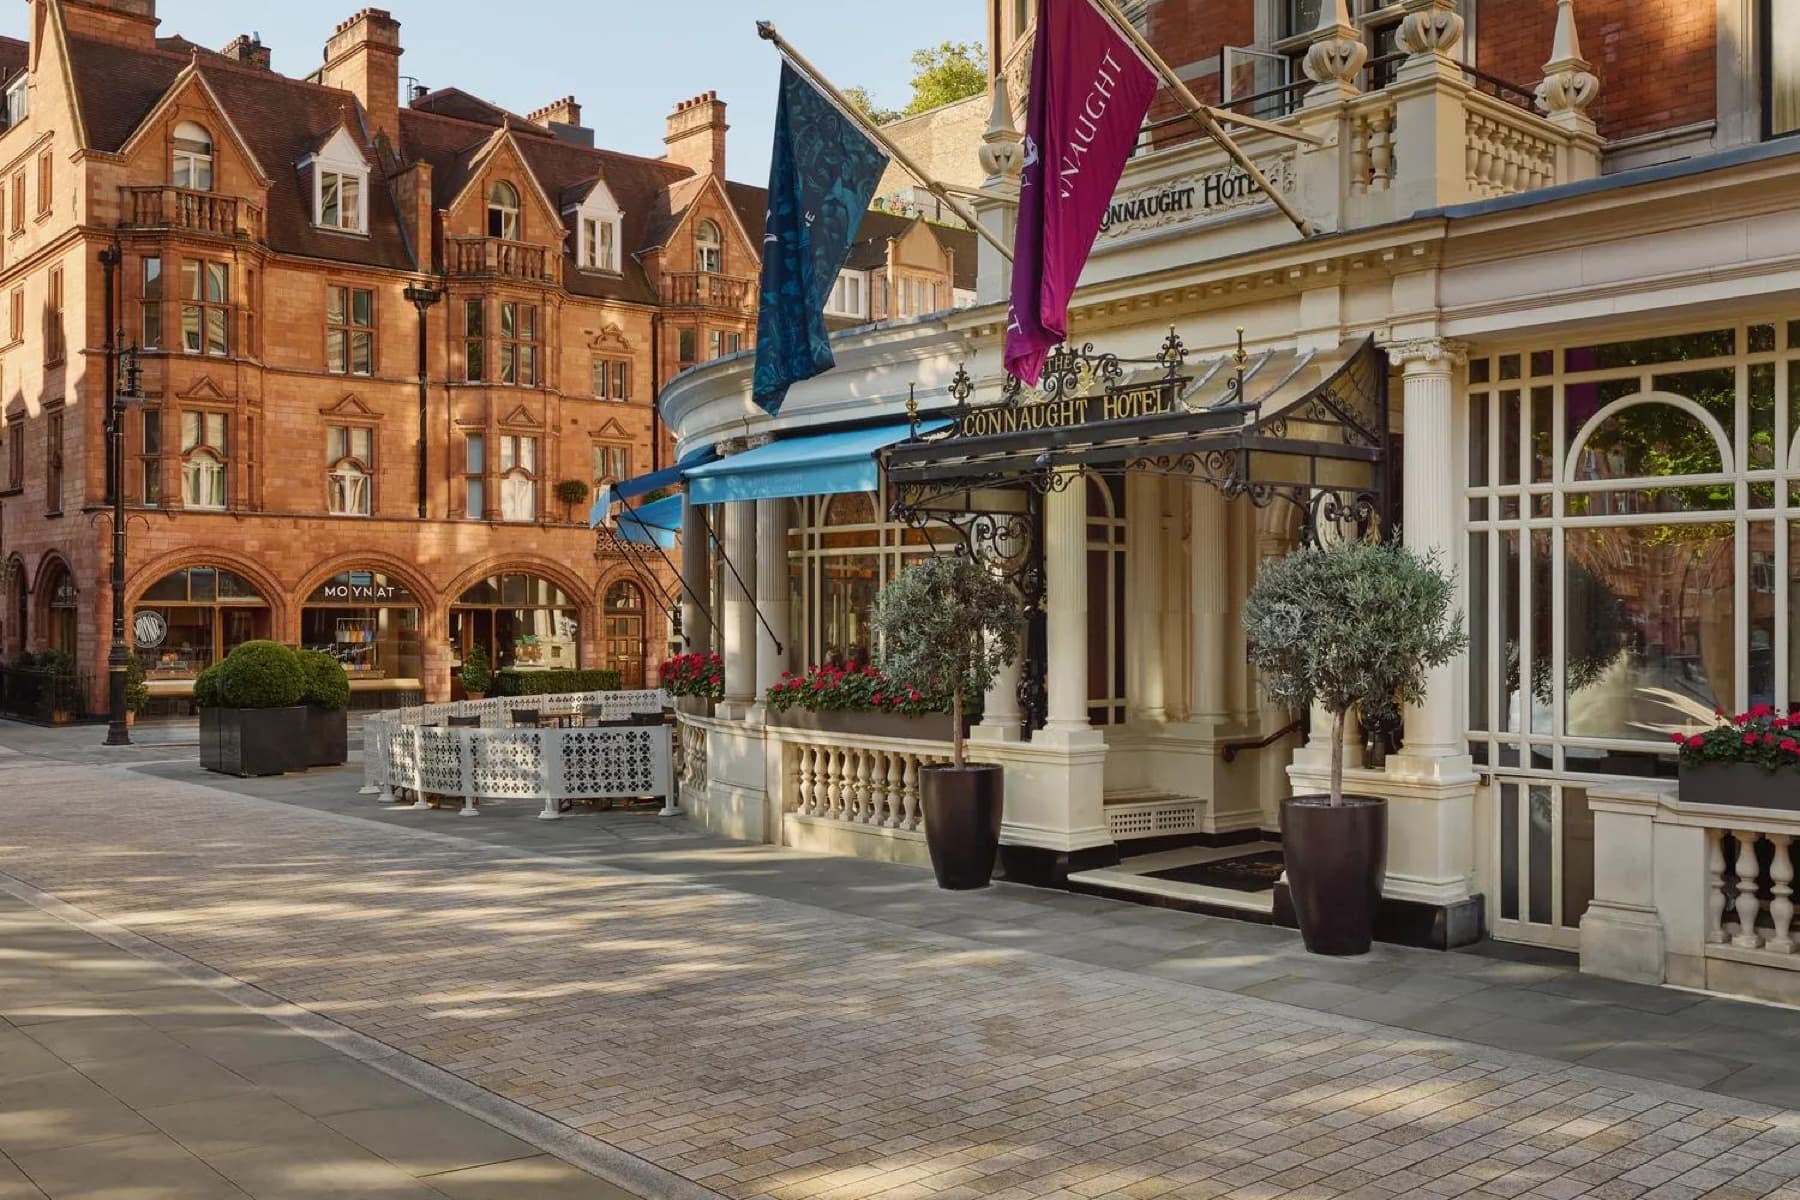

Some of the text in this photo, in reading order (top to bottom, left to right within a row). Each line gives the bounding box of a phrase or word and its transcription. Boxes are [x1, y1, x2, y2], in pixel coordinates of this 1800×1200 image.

[1099, 188, 1194, 232] ONNAUGHT
[1045, 355, 1073, 371] THE
[963, 388, 1171, 437] CONNAUGHT HOTEL
